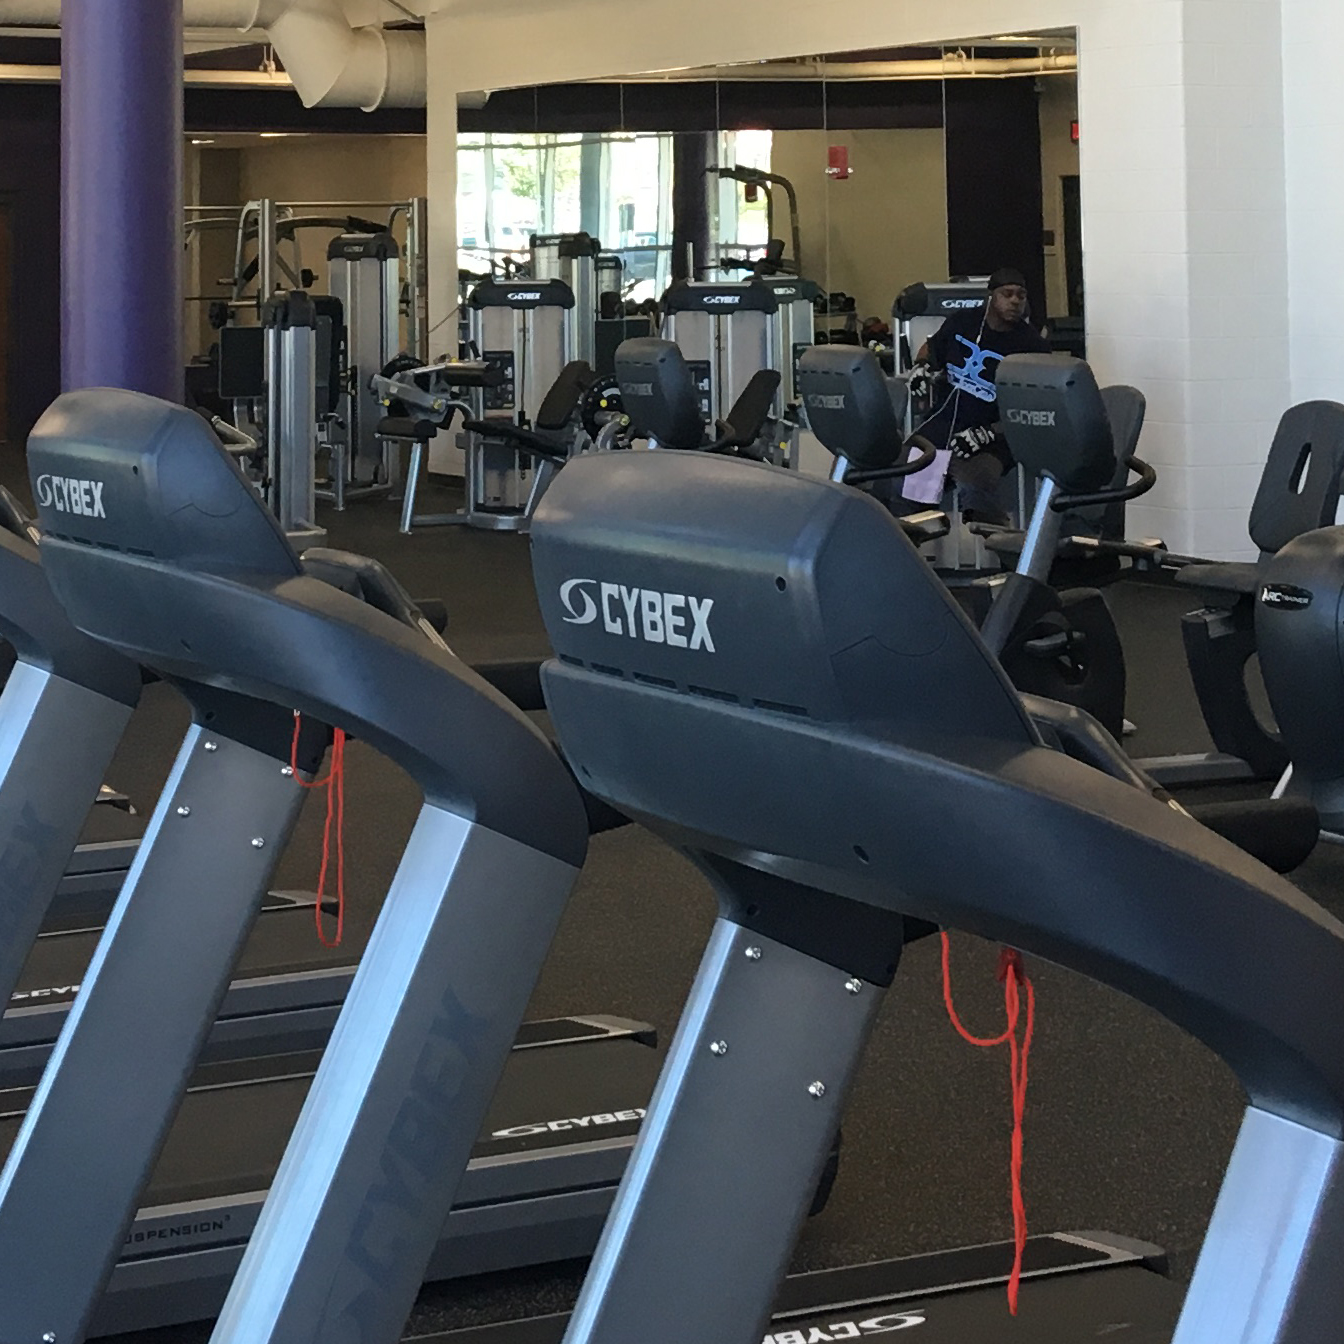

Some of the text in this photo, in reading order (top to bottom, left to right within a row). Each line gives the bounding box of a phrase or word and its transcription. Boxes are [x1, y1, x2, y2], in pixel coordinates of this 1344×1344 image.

[714, 295, 740, 304] CYBEX
[1019, 409, 1056, 427] CYBEX
[51, 476, 107, 519] CYBEX
[1261, 587, 1281, 602] ARC
[600, 581, 716, 653] CYBEX
[343, 984, 488, 1290] CYBEX
[762, 1321, 861, 1344] CYB
